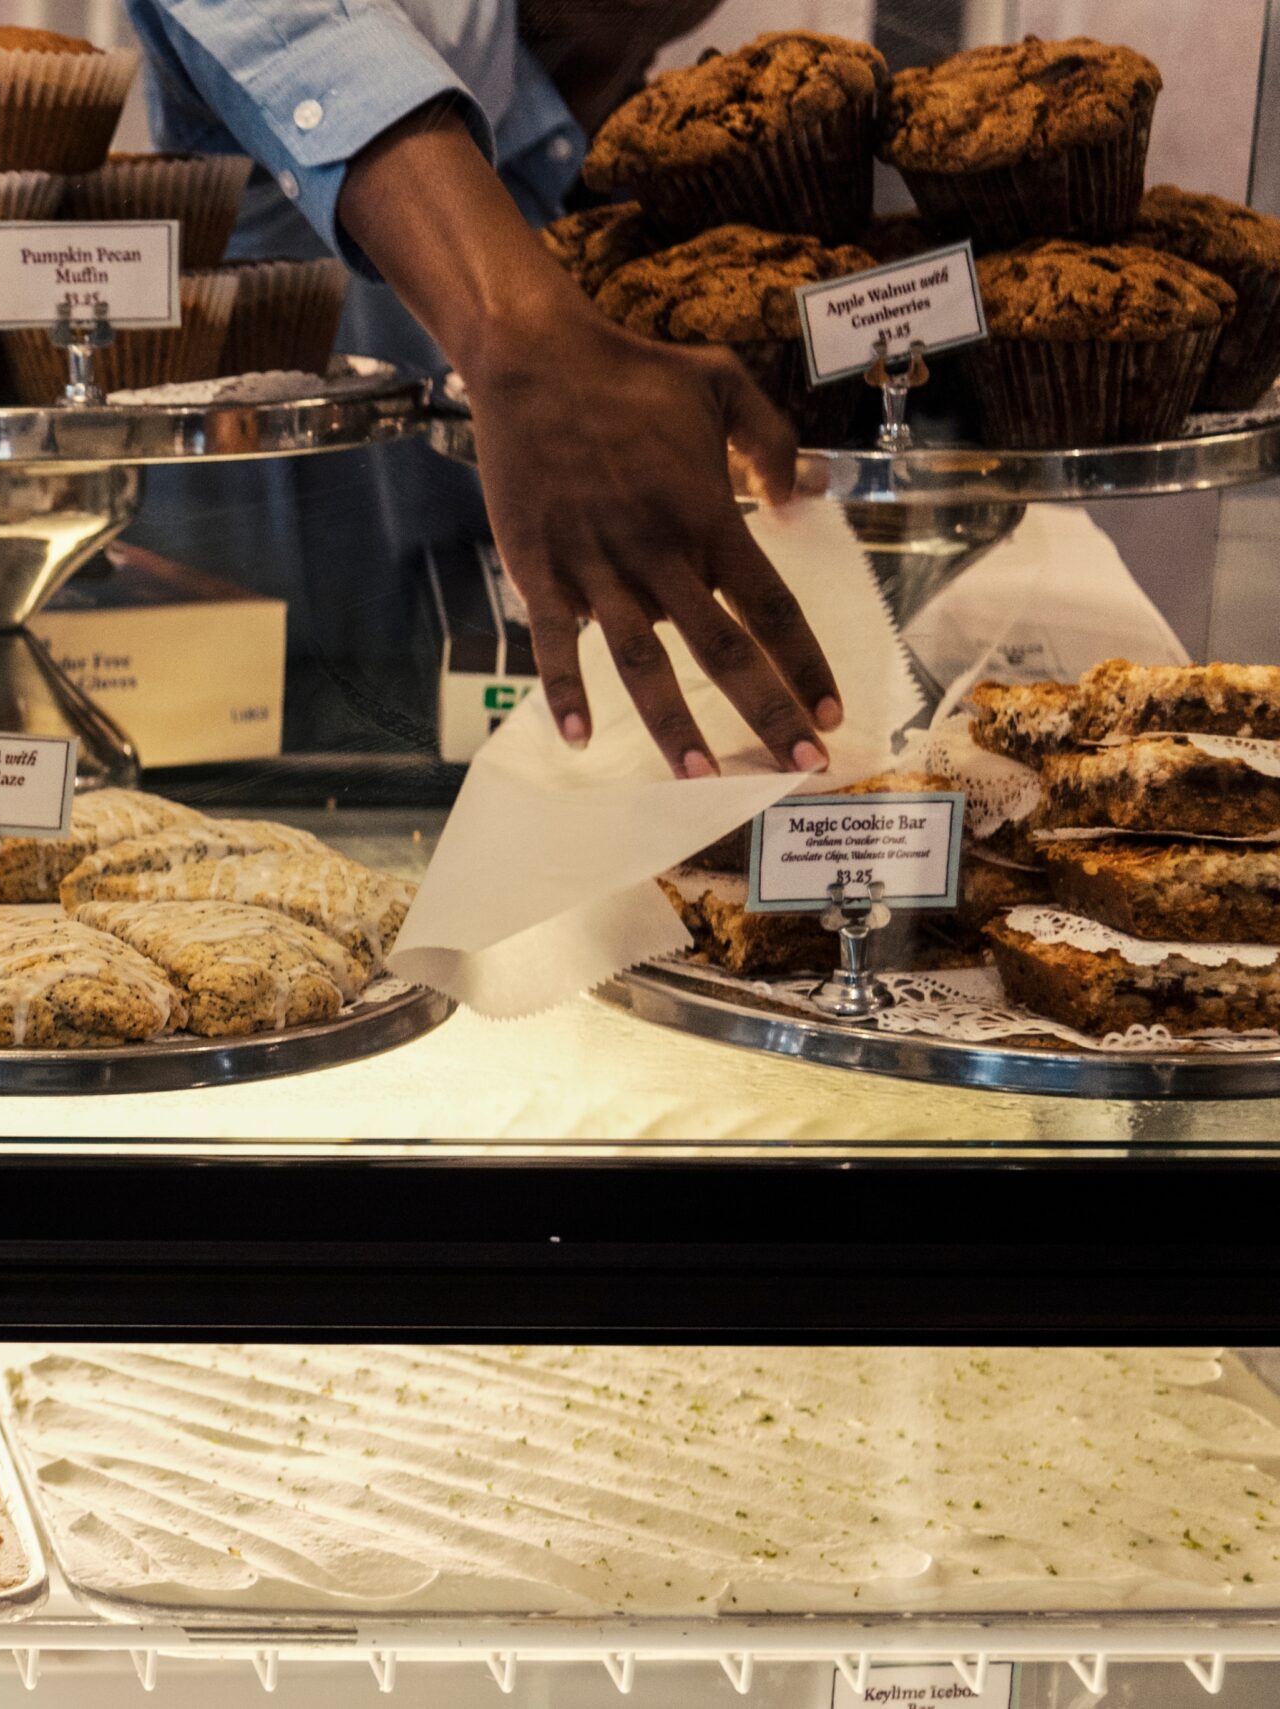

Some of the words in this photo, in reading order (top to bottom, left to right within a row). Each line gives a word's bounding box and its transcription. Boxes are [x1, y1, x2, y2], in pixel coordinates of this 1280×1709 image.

[21, 246, 93, 266] Pumpkin
[96, 247, 142, 263] Pecan
[55, 267, 109, 284] Muffin
[826, 293, 865, 317] Apple
[868, 279, 917, 304] Walnut
[919, 264, 950, 291] with
[851, 297, 931, 330] Cranberries
[4, 749, 38, 767] with
[788, 817, 838, 836] Magic
[841, 814, 894, 832] Cookie
[897, 815, 927, 830] Bar
[805, 836, 842, 847] Graham
[844, 835, 880, 846] Cracker
[781, 851, 823, 863] Chocolate
[851, 848, 886, 860] Walnuts
[895, 848, 930, 859] Coconut
[836, 868, 873, 886] $3.25
[864, 1683, 926, 1704] Keylime
